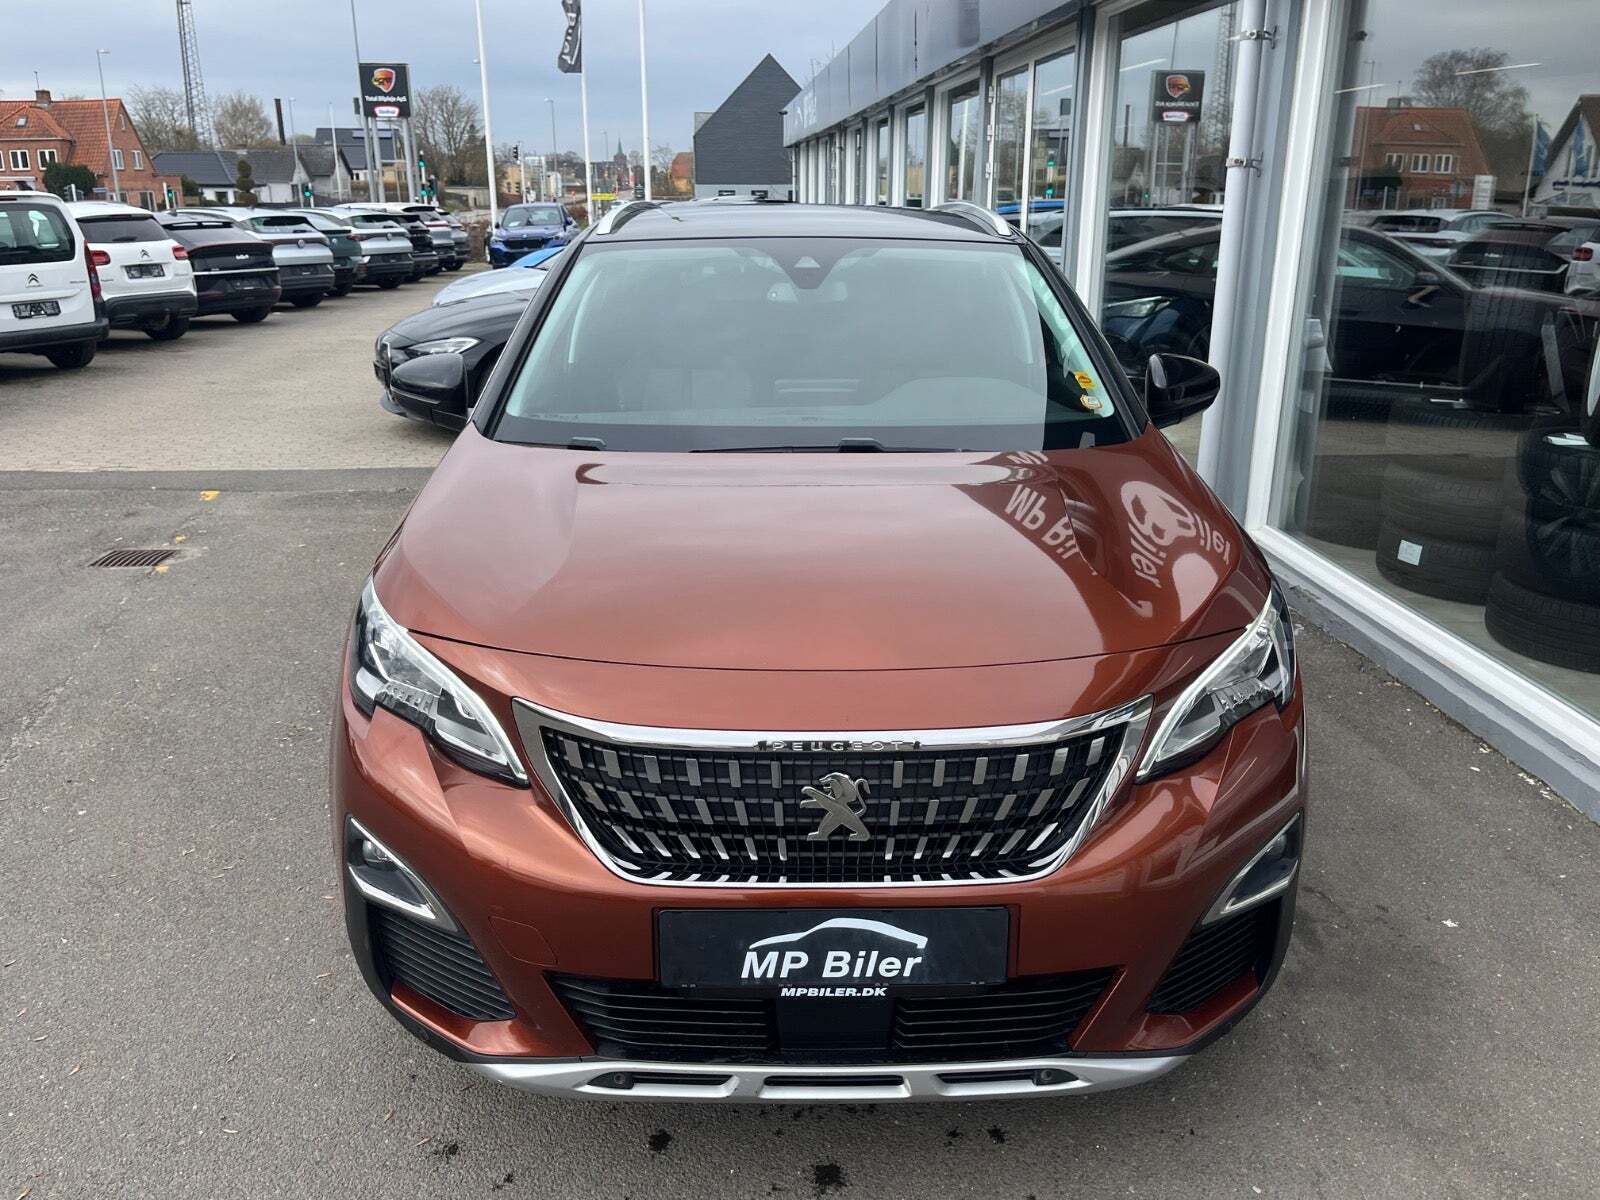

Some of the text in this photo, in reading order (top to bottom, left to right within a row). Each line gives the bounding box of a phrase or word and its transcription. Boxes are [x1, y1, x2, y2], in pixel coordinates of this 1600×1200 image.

[771, 740, 904, 751] PEUGEOT
[740, 950, 923, 979] MP Biler
[780, 987, 889, 998] MPBILER.DK
